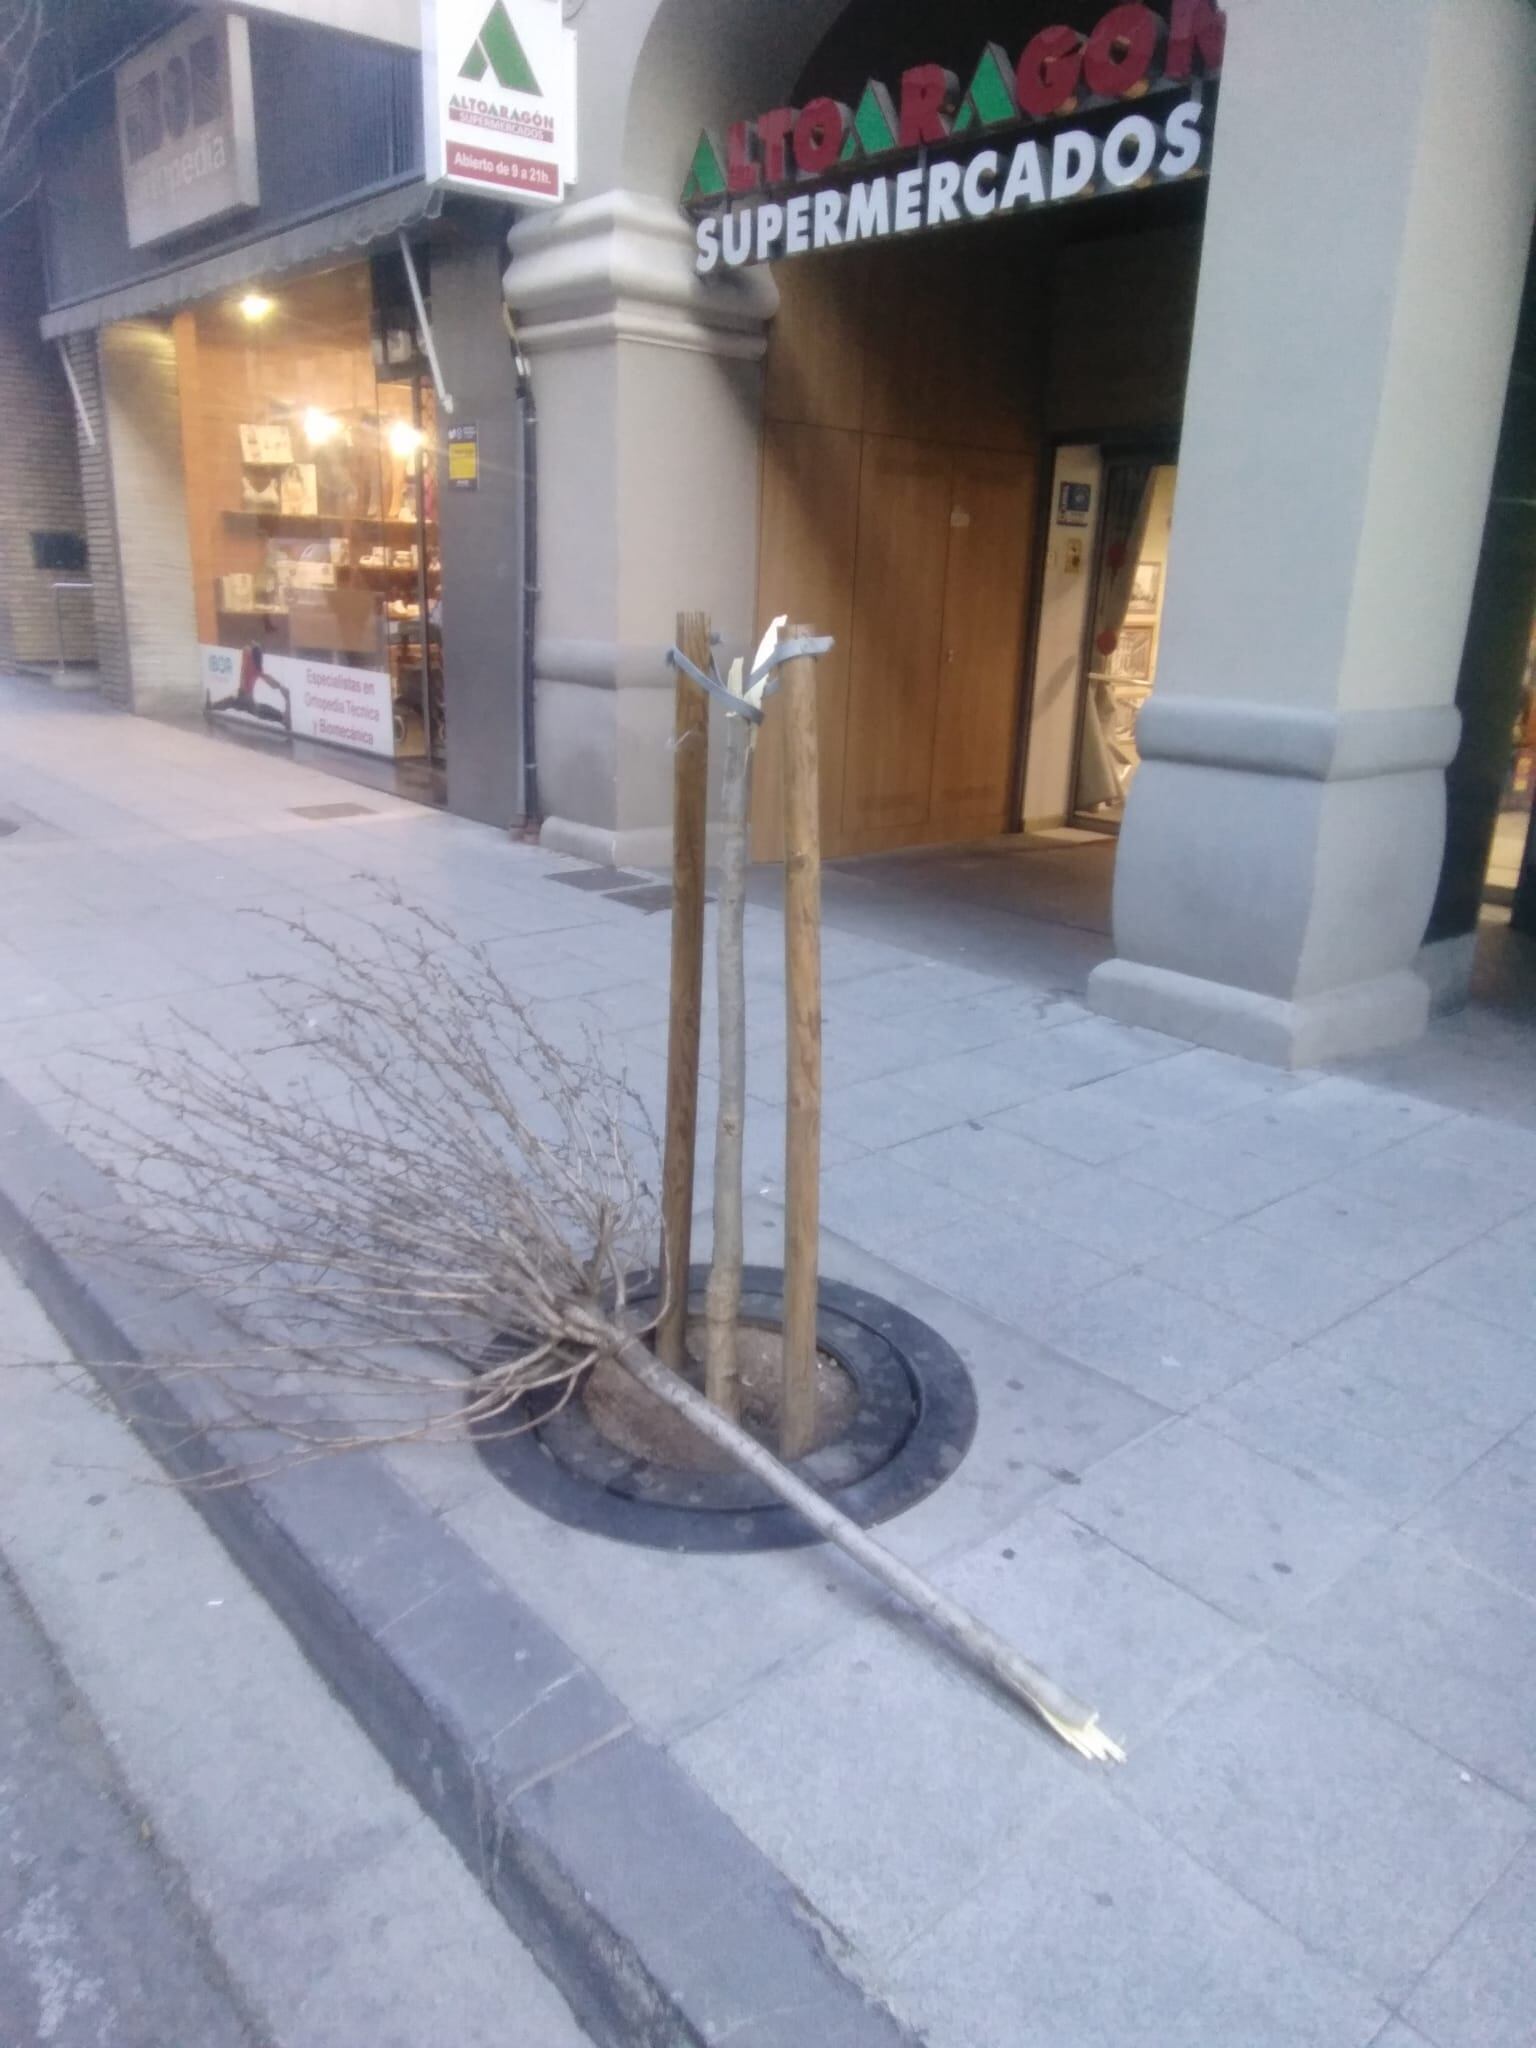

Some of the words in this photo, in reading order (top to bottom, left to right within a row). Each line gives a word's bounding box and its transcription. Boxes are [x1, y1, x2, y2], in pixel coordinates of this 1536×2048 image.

[459, 110, 545, 141] SUPERMERCADOS
[454, 152, 494, 172] Abierto
[496, 161, 509, 175] de
[511, 164, 519, 178] 9
[521, 168, 528, 179] a
[530, 167, 552, 184] 21h.
[696, 101, 1203, 274] SUPERMERCADOS
[306, 668, 361, 693] Especialistas
[363, 682, 375, 696] en
